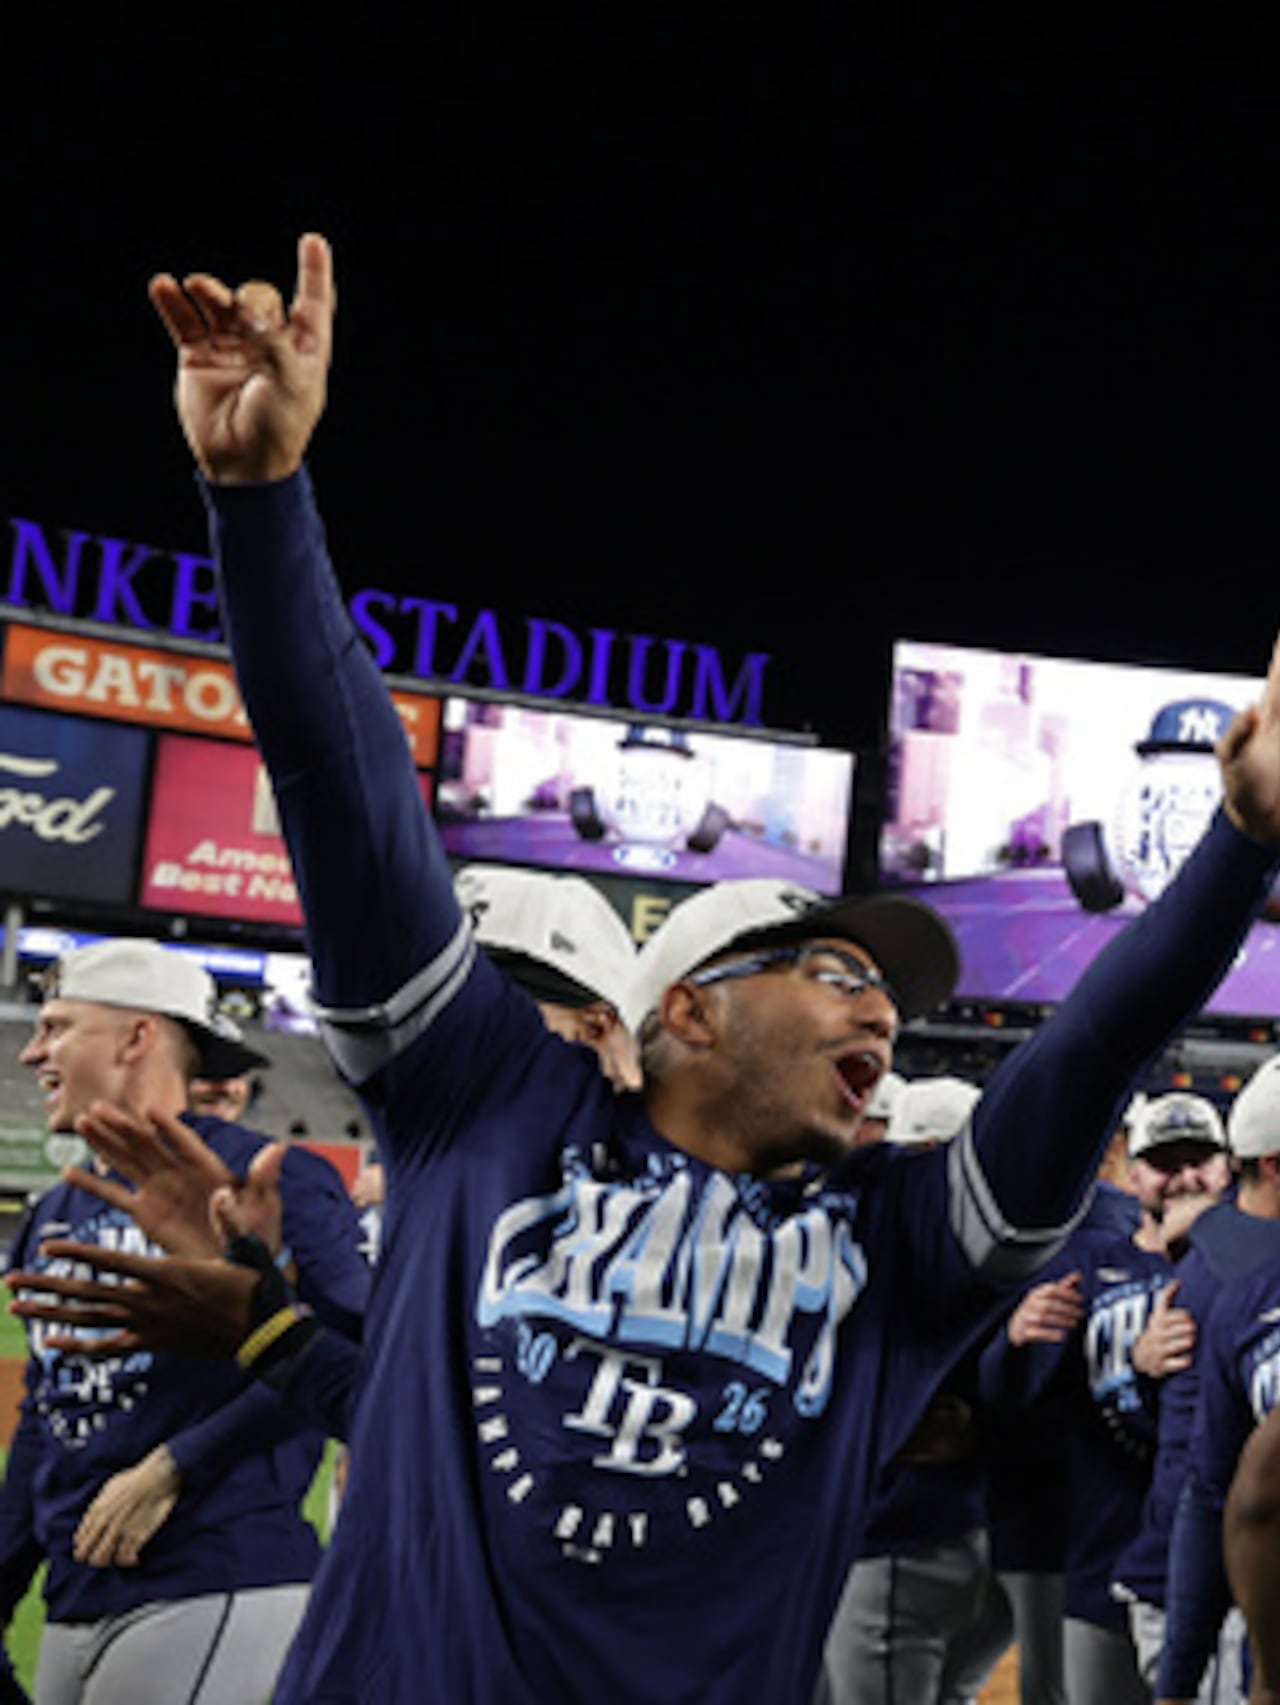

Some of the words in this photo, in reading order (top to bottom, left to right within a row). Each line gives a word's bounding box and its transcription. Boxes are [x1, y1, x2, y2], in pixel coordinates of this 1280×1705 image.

[33, 644, 246, 722] GATO
[350, 588, 773, 728] STADIUM
[477, 1170, 868, 1418] CHAMPS
[712, 1381, 770, 1435] 26
